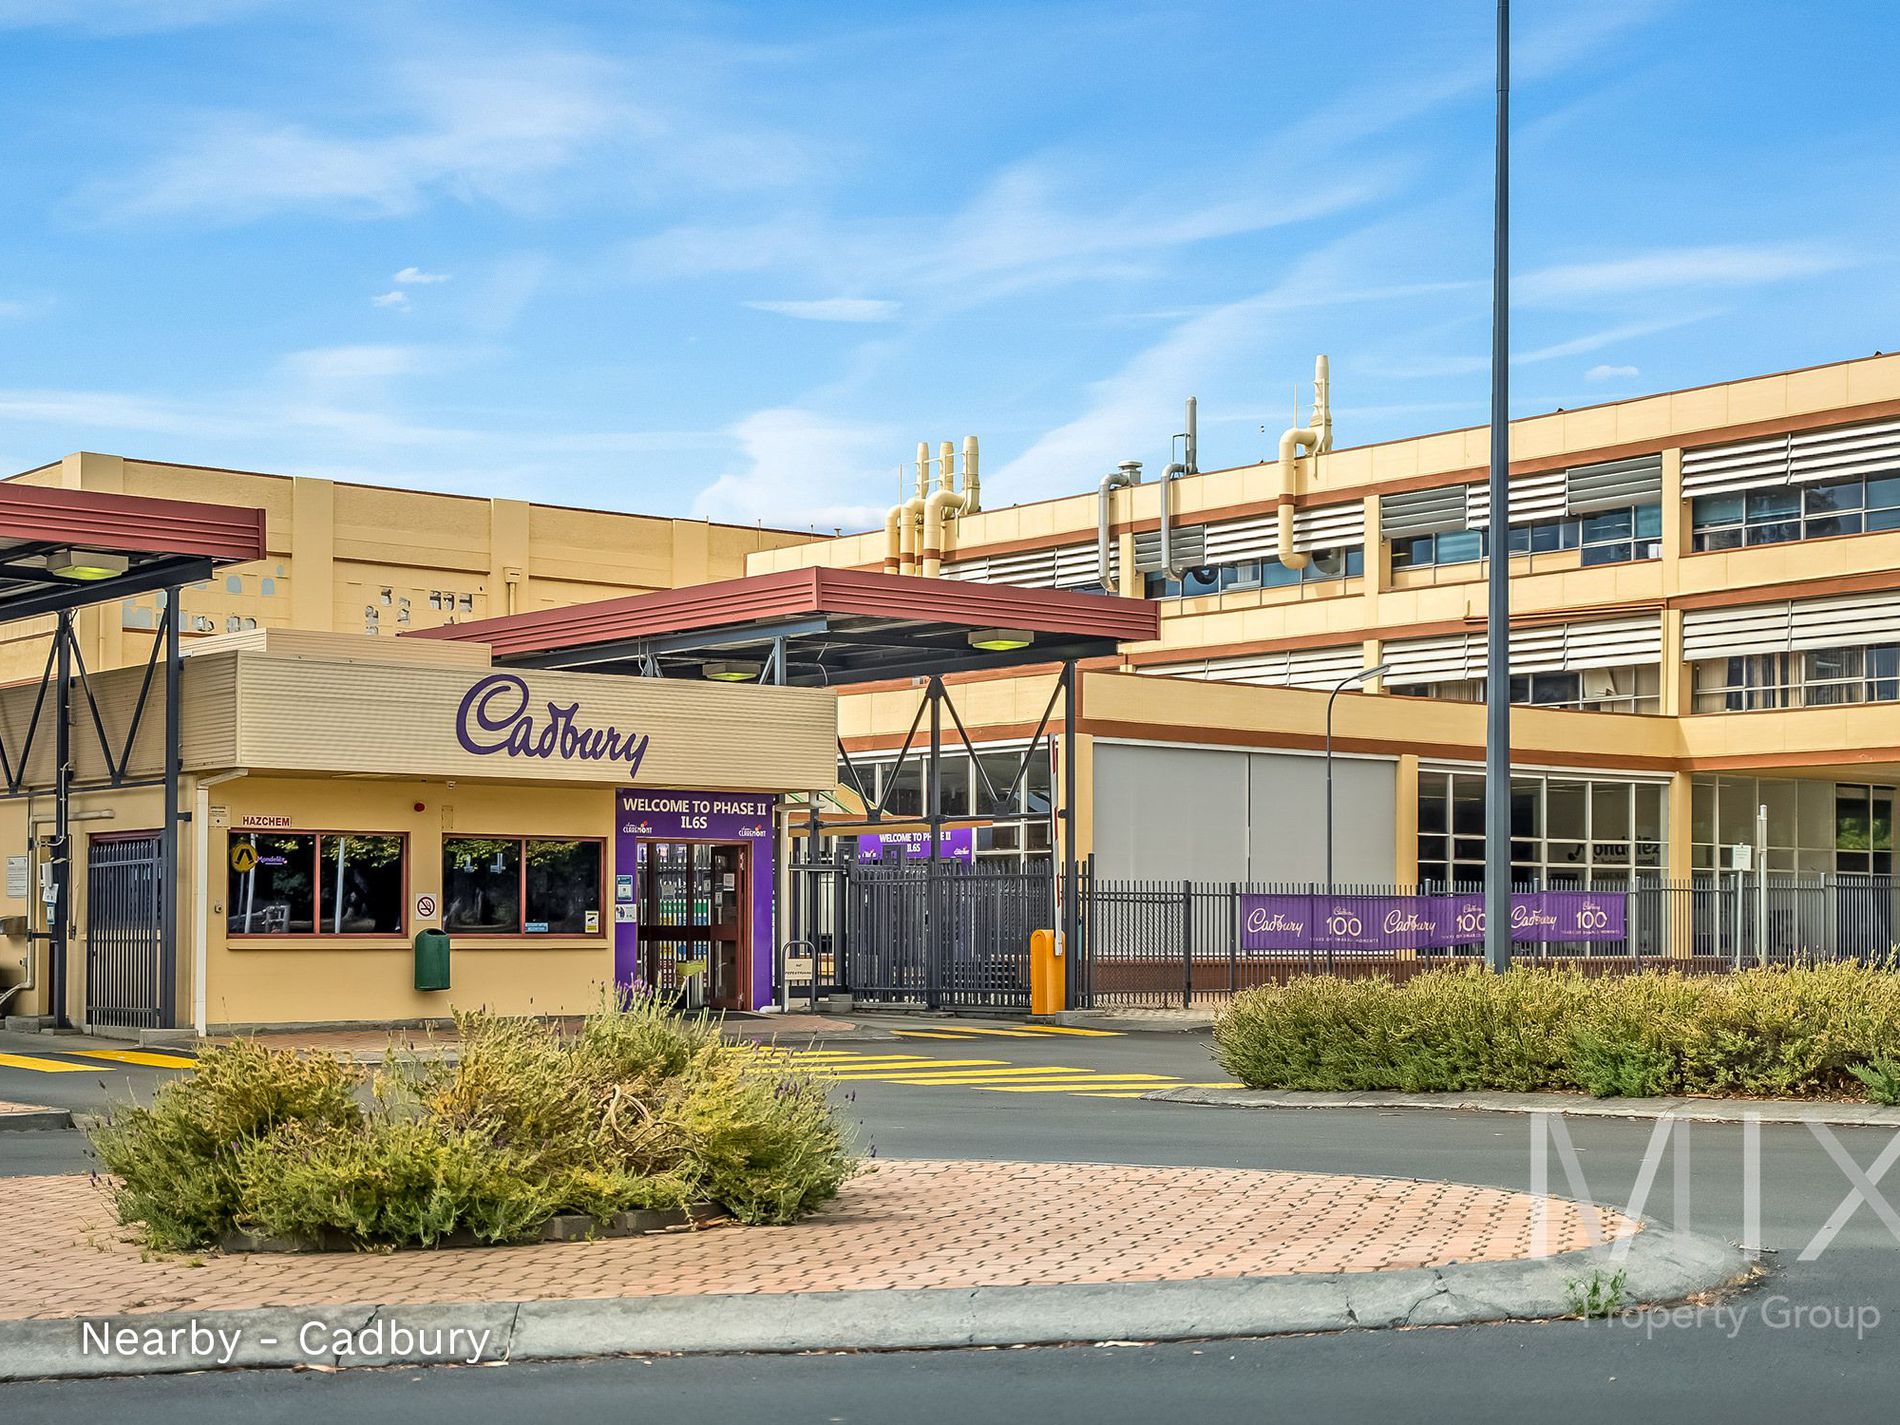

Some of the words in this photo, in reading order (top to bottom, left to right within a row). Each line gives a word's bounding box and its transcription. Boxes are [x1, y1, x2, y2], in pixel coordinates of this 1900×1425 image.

[456, 673, 650, 779] Cadbury
[623, 798, 690, 812] WELCOME
[692, 801, 711, 814] TO
[713, 801, 754, 815] PHASE
[757, 803, 767, 815] II
[242, 816, 290, 826] HAZCHEM
[879, 833, 912, 843] WELCOME
[913, 833, 922, 841] TO
[923, 832, 944, 841] PHE
[1247, 908, 1304, 937] Cadbury
[1326, 916, 1362, 936] 100
[1384, 909, 1437, 937] Cadbury
[1456, 913, 1486, 932] 100
[1510, 905, 1558, 930] Cadbury
[1576, 911, 1608, 929] 100
